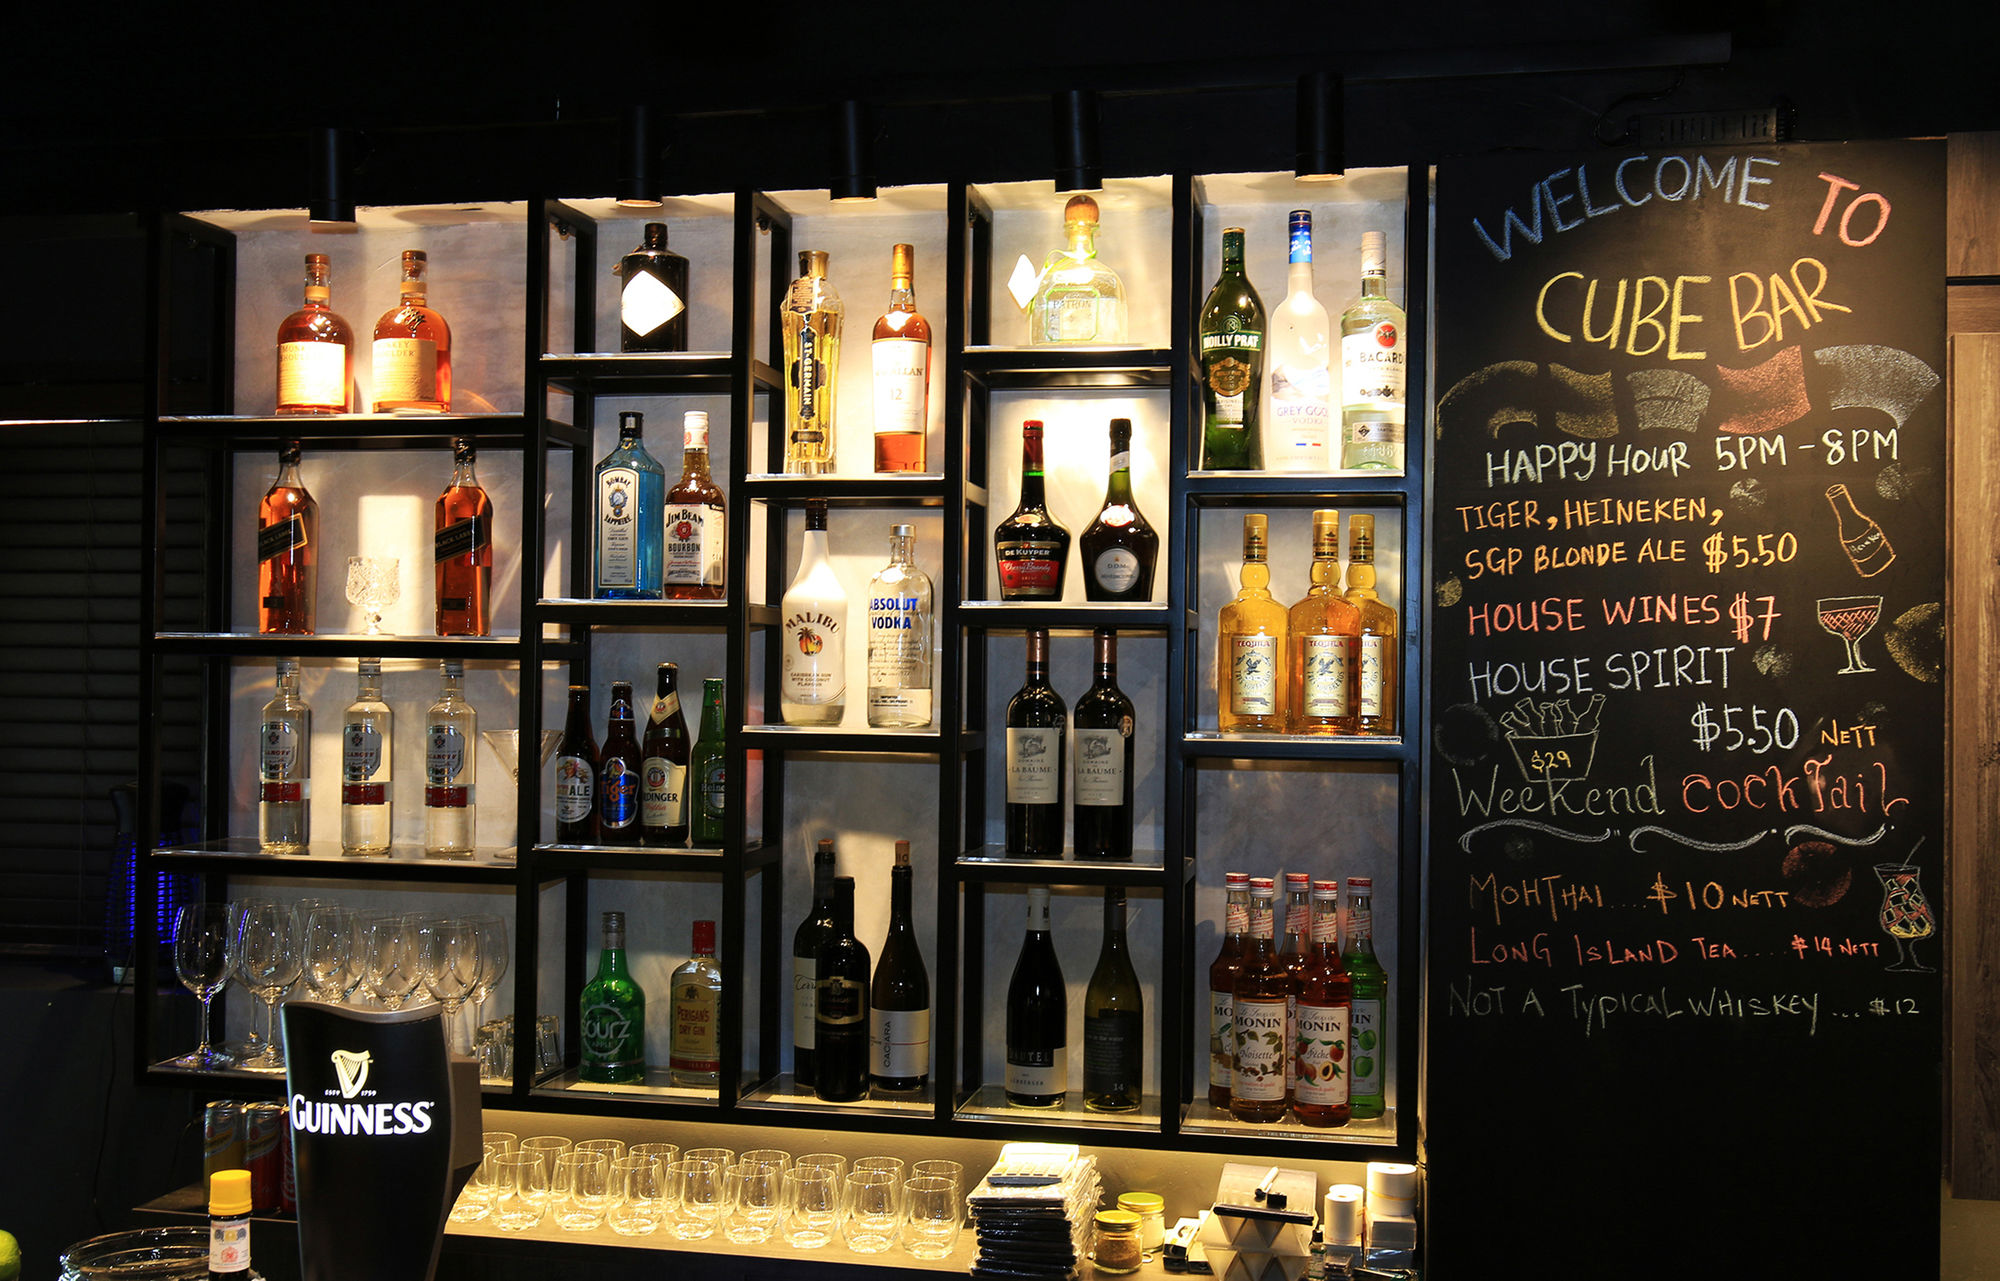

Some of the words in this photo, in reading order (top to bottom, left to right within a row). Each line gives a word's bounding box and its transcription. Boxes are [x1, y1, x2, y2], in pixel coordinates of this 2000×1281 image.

[1473, 154, 1781, 261] WELCOME
[1814, 172, 1891, 247] TO
[1536, 271, 1712, 361] CUBE
[1729, 258, 1852, 351] BAR
[1203, 334, 1234, 349] NOILLY
[1234, 333, 1260, 348] PRAT
[1277, 405, 1303, 416] GREY
[1305, 405, 1328, 417] GOO
[1486, 438, 1598, 487] HAPPY
[1608, 440, 1691, 477] HOUR
[1716, 434, 1787, 472] 5PM
[1821, 427, 1900, 466] 8PM
[606, 476, 631, 487] BOMBAY
[604, 515, 632, 526] SAPPHIRE
[668, 543, 701, 553] BOURBON
[1464, 548, 1522, 581] SGP
[1534, 541, 1628, 573] BLONDE
[1638, 538, 1687, 564] ALE
[1702, 531, 1799, 574] $5.50
[870, 598, 918, 611] ABSOLUT
[785, 611, 841, 635] MALIBU
[872, 616, 912, 630] VODKA
[1469, 597, 1586, 637] HOUSE
[1602, 594, 1720, 627] WINES
[1729, 591, 1782, 643] $7
[1236, 640, 1270, 648] TEQUILA
[1469, 657, 1594, 704] HOUSE
[1604, 646, 1736, 692] SPIRIT
[1690, 701, 1800, 753] $5.50
[1531, 749, 1572, 773] $29
[569, 784, 591, 797] ALE
[601, 779, 637, 802] Tiger
[1471, 926, 1552, 967] LONG
[1692, 937, 1738, 961] TEA
[1791, 934, 1833, 960] $14
[1449, 976, 1505, 1018] NOT
[1522, 987, 1545, 1018] A
[1869, 997, 1919, 1016] $12
[1235, 1015, 1281, 1028] MONIN
[291, 1094, 432, 1135] GUINNESS
